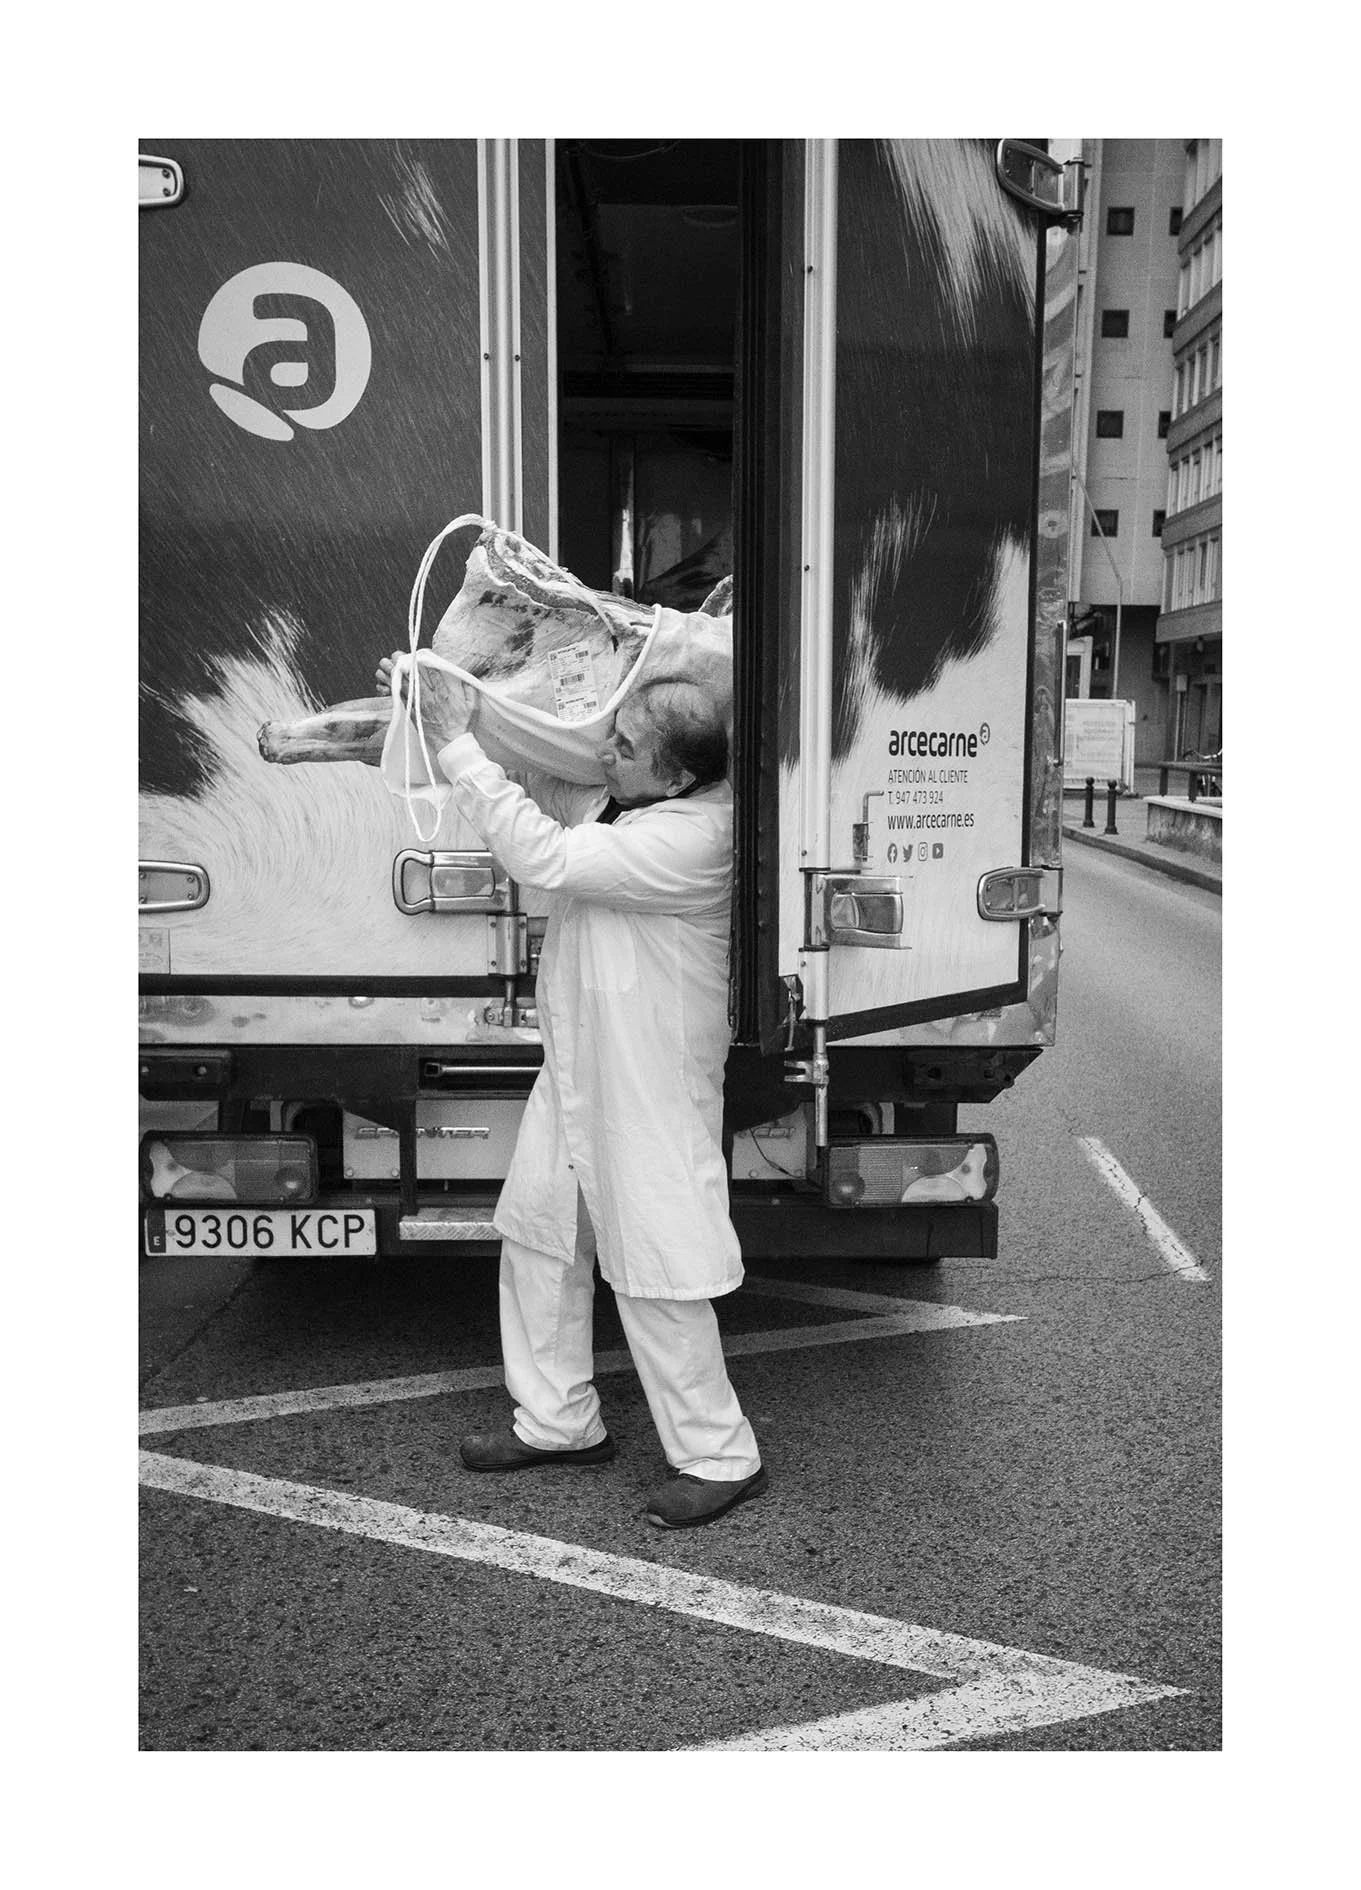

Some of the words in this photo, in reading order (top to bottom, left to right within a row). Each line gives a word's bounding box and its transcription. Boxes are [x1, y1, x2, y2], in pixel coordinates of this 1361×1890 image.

[889, 730, 978, 758] arcecarne
[888, 767, 926, 783] ATENCIÓN
[928, 769, 937, 783] AL
[939, 769, 968, 783] CLIENTE
[896, 790, 911, 805] 947
[912, 790, 927, 804] 473
[929, 790, 944, 804] 924
[887, 813, 975, 830] www.arcecarne.es
[153, 1236, 160, 1246] E
[175, 1214, 275, 1249] 9306
[290, 1214, 366, 1249] KCP
